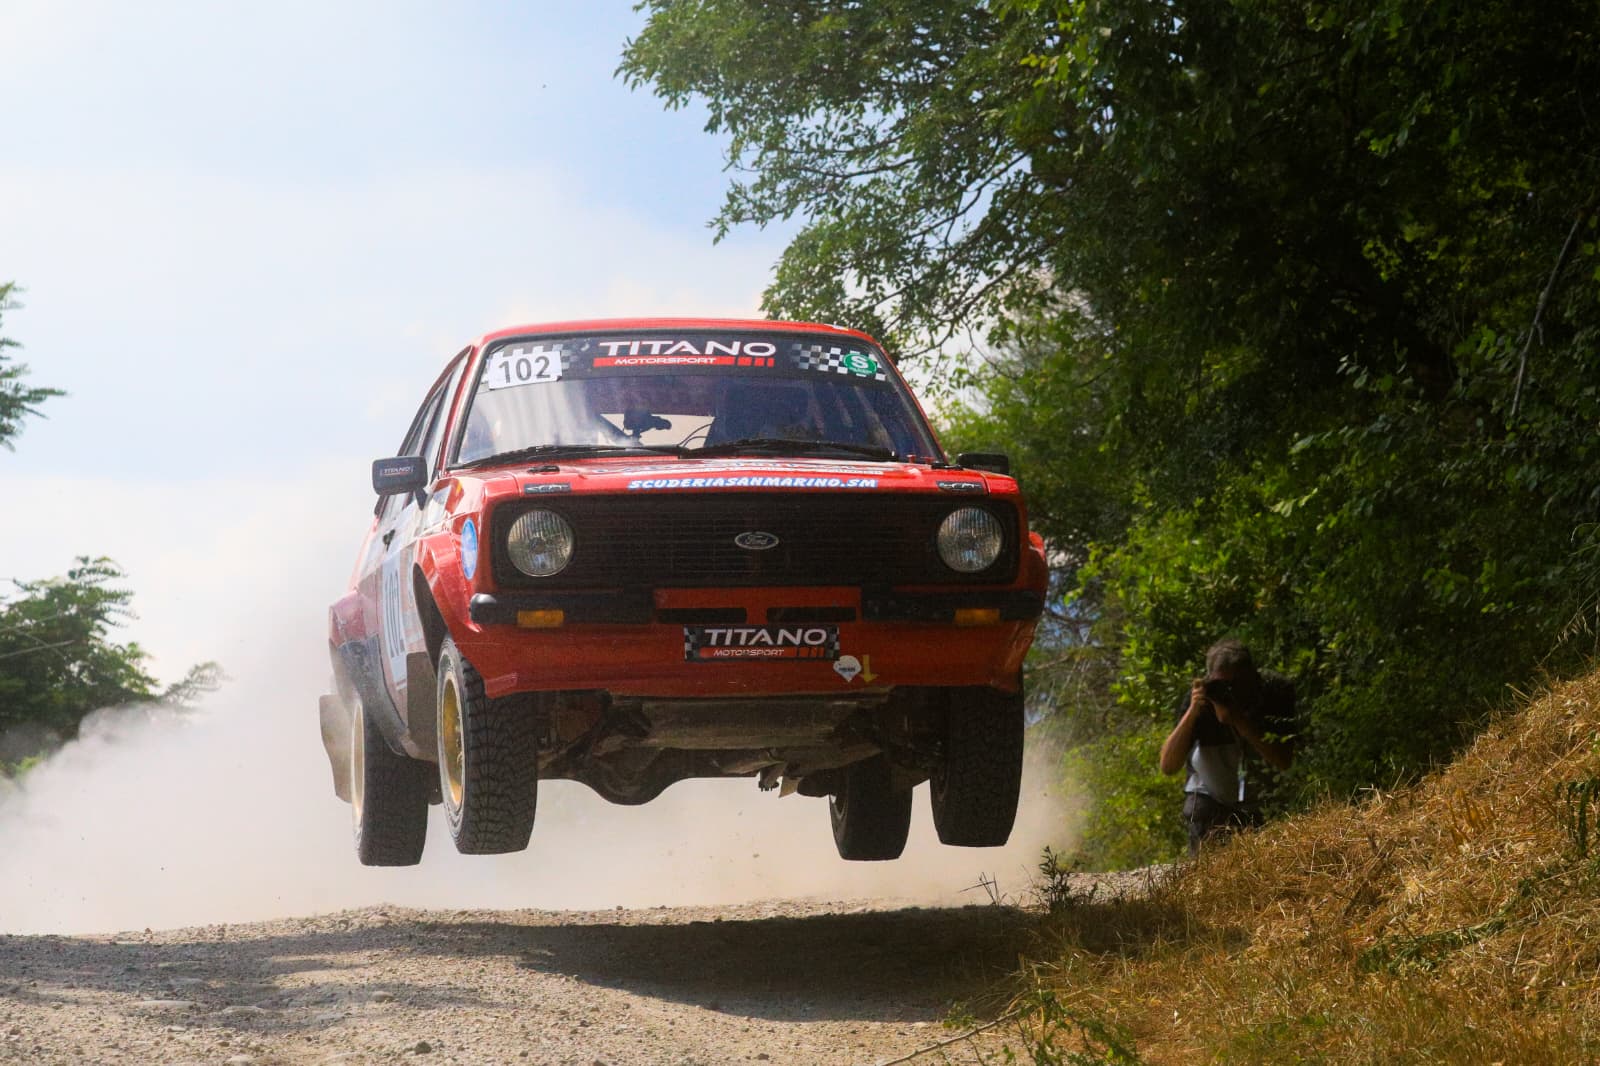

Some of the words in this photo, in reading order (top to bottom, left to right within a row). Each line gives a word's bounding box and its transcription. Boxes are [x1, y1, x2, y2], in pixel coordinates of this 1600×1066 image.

[599, 340, 776, 356] TITANO
[614, 357, 717, 365] MOTORSPORT
[498, 355, 551, 384] 102
[628, 477, 878, 490] SCUDERIASANMARINO.SM
[704, 628, 827, 646] TITANO
